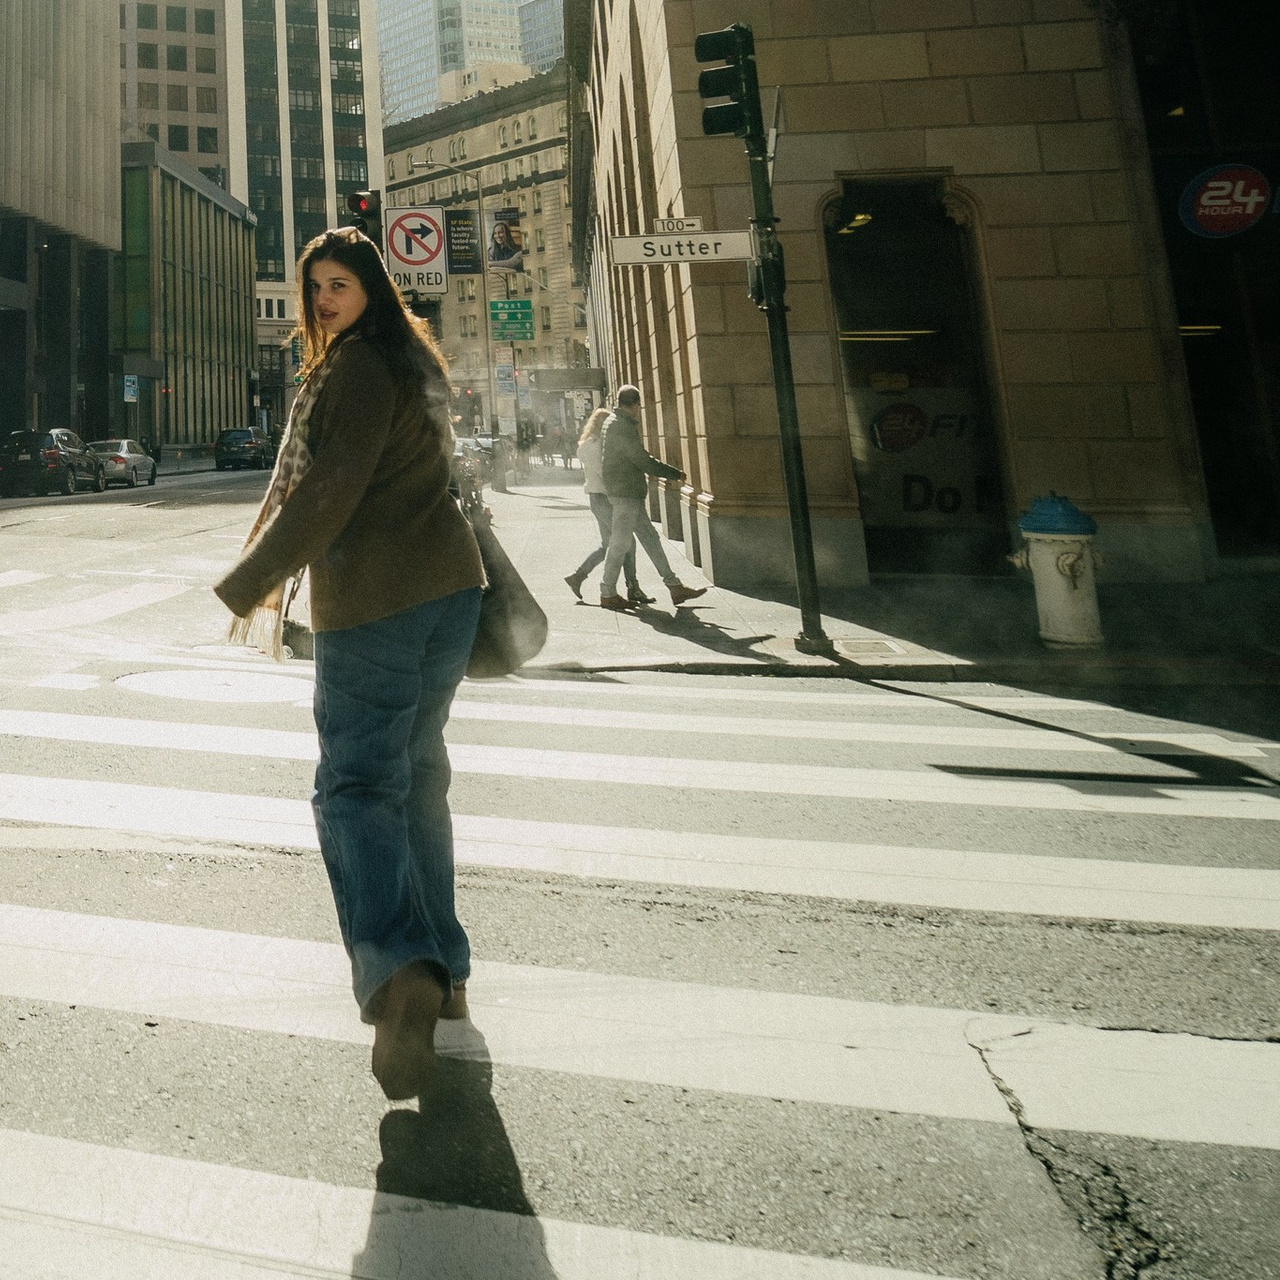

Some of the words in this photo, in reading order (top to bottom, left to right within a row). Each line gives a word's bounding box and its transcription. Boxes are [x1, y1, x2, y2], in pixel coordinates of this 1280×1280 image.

[1201, 181, 1265, 214] 24
[1198, 206, 1244, 216] HOUR
[661, 220, 685, 231] 100
[643, 240, 722, 257] Sutter
[394, 273, 412, 287] ON
[417, 272, 443, 286] RED
[497, 302, 522, 310] Post
[902, 474, 963, 515] Do
